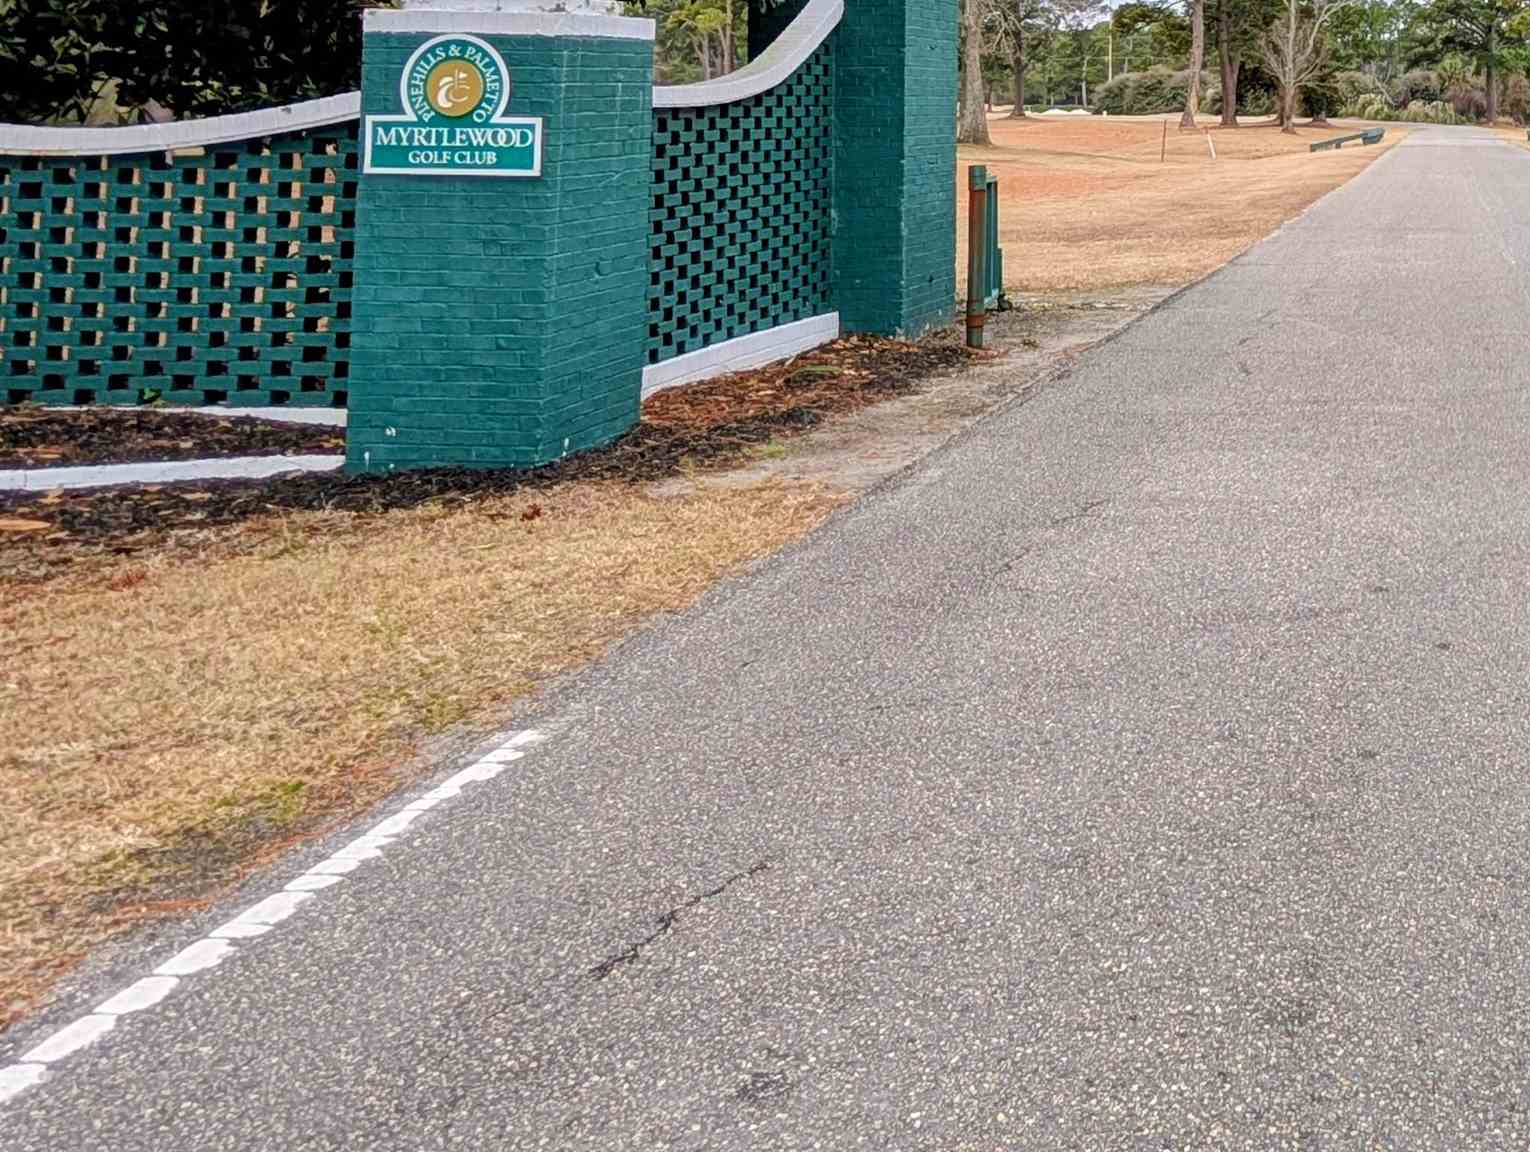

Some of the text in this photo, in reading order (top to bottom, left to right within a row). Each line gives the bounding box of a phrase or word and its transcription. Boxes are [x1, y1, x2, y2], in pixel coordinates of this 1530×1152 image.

[448, 44, 461, 57] &
[376, 127, 533, 148] MYRTLEWOOD
[408, 151, 497, 165] GOLF CLUB
